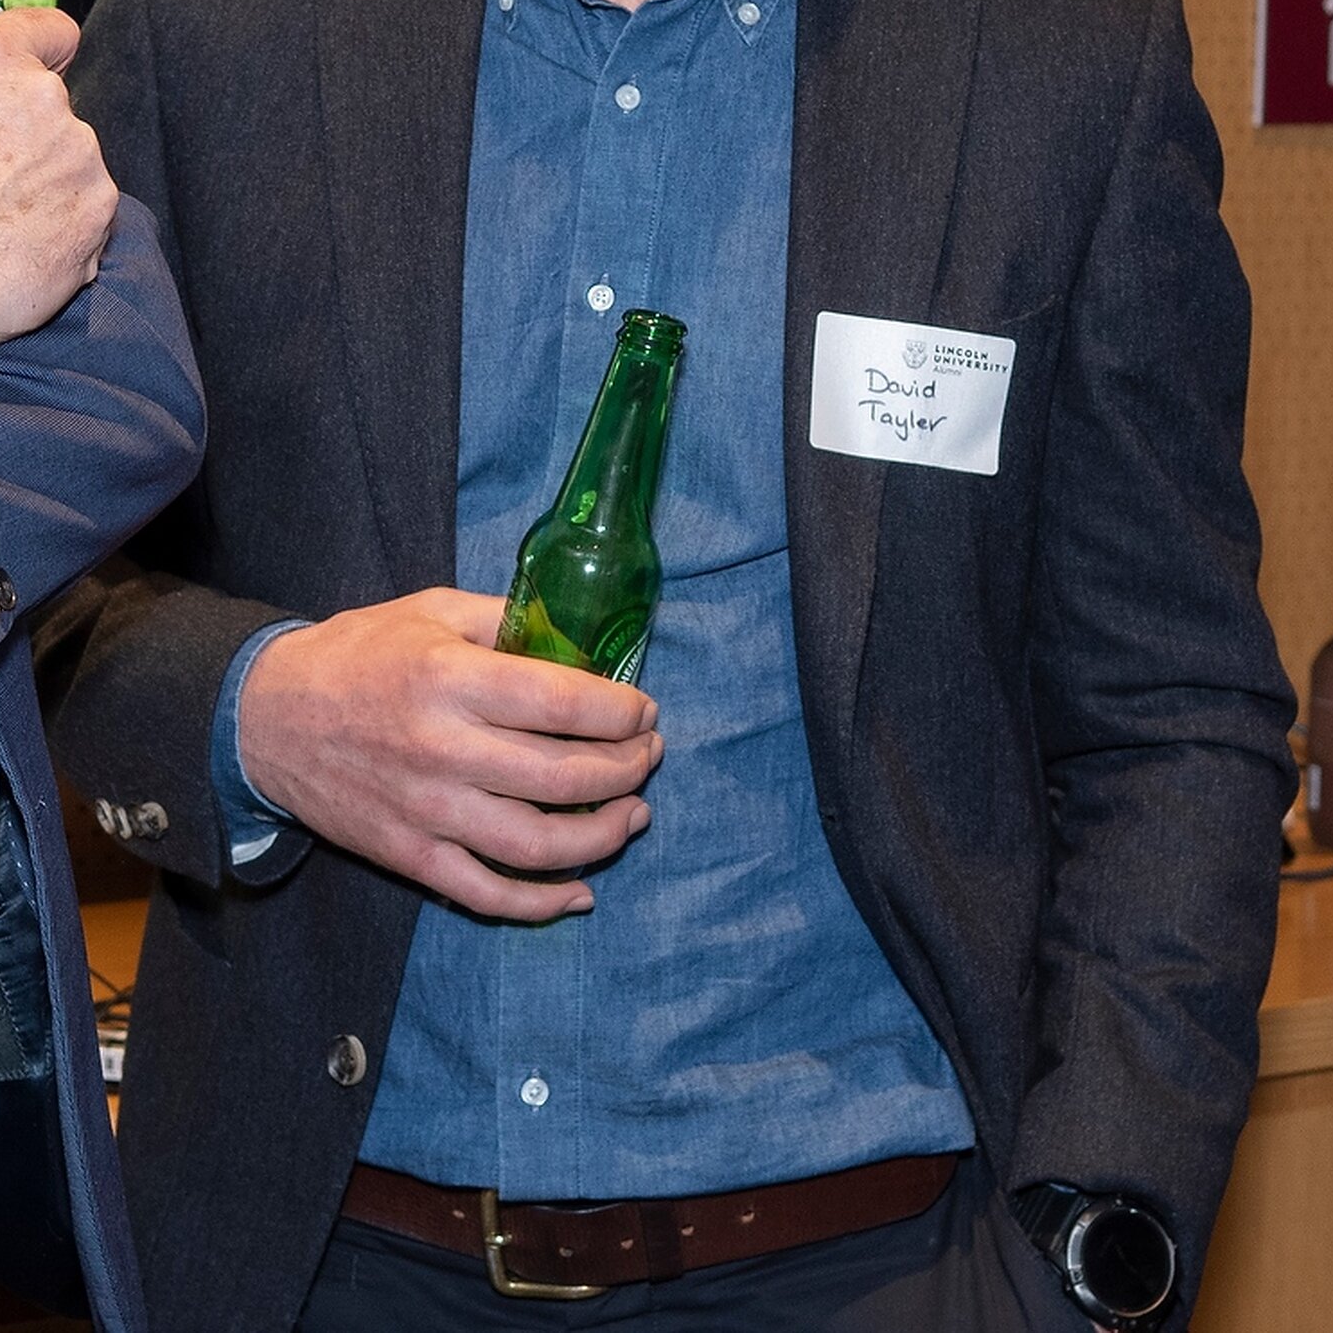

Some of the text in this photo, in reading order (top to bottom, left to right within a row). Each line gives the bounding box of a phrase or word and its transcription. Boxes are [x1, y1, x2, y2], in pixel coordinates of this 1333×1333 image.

[934, 344, 989, 361] LINCOLN
[933, 354, 1009, 374] UNIVERSITY
[864, 367, 937, 399] David
